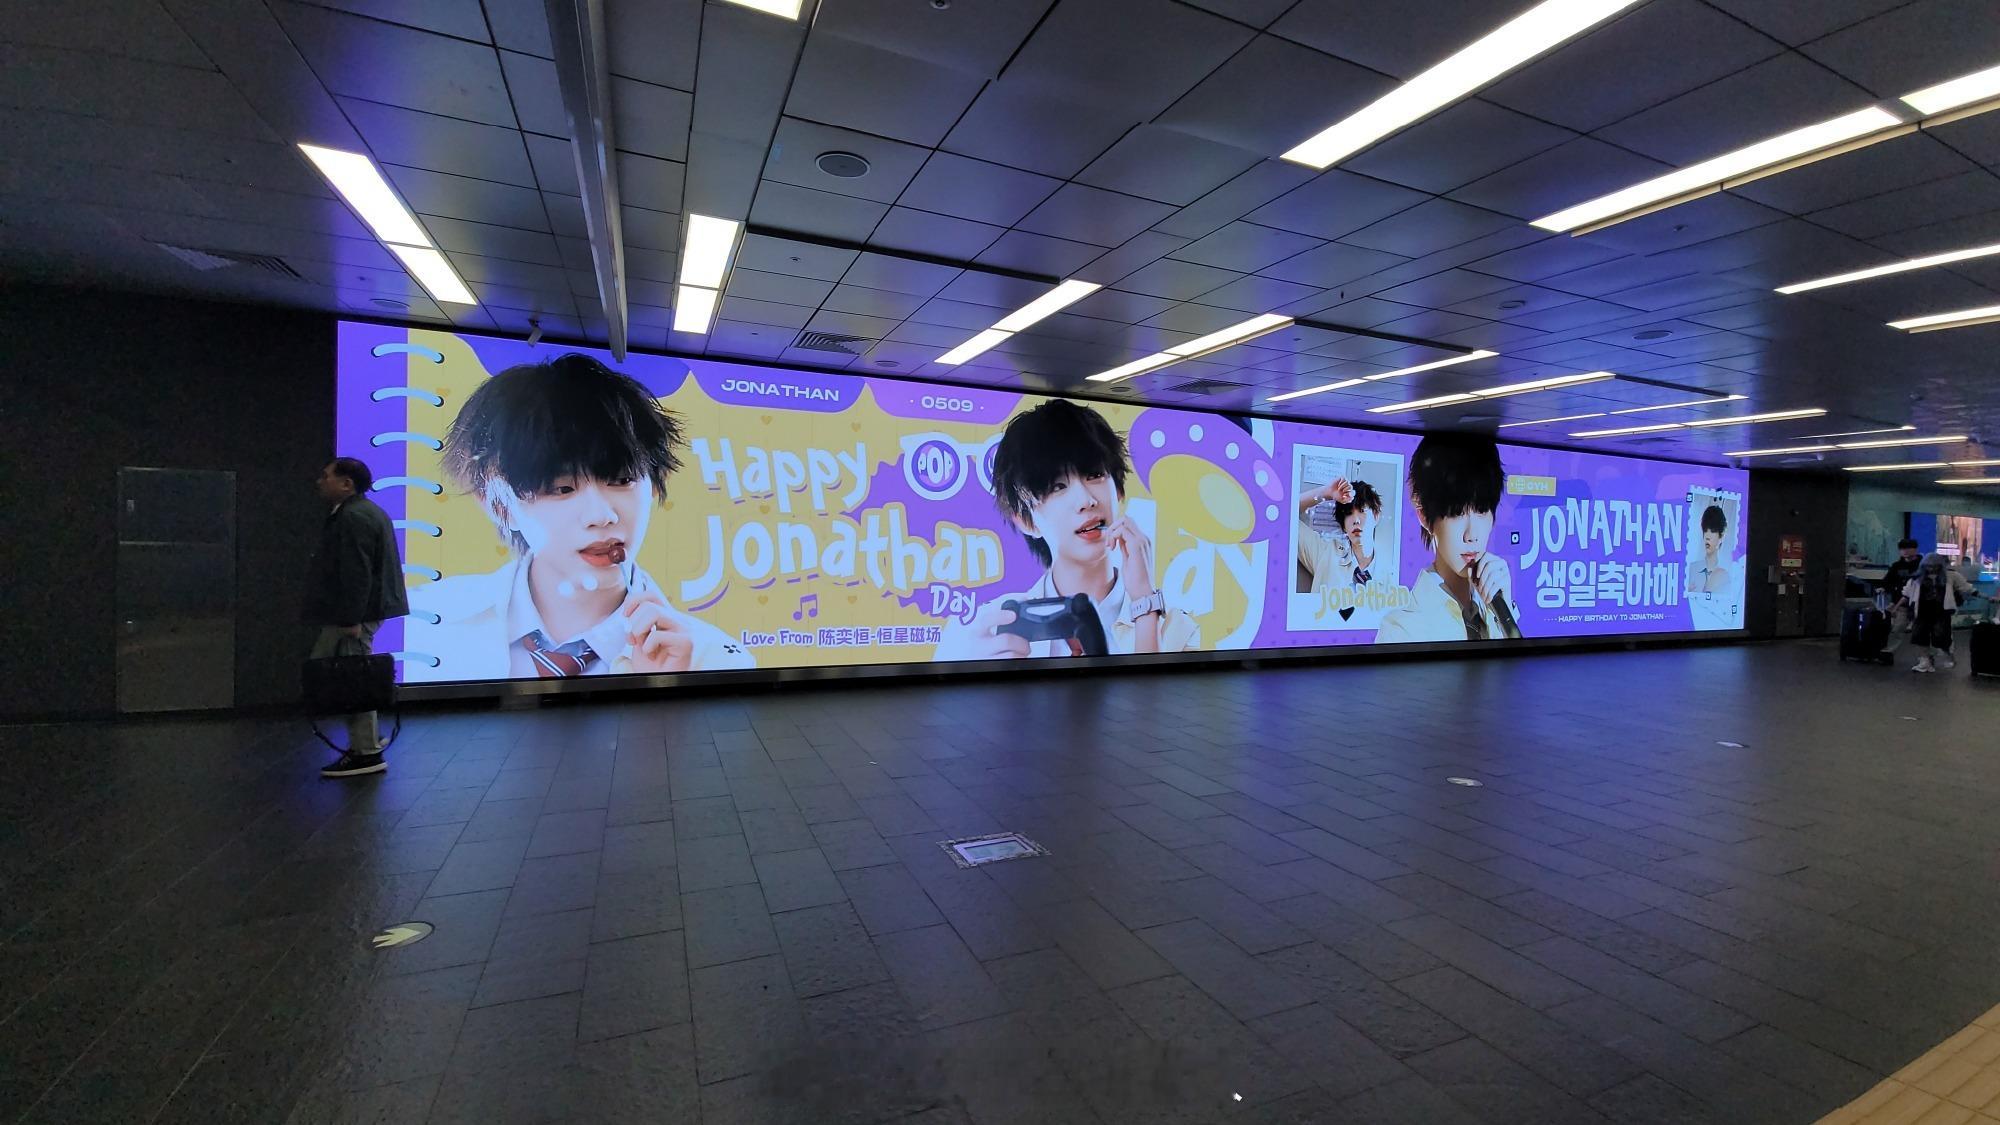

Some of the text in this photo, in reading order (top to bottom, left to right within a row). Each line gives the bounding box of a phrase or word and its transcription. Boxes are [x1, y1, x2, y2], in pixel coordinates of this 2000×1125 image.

[721, 379, 840, 401] JONATHAN
[921, 395, 974, 412] 0509
[691, 437, 867, 513] Happy
[918, 446, 953, 484] POP
[1521, 497, 1682, 570] JONATHAN
[680, 508, 1000, 602] Jonathan
[929, 586, 976, 617] Day
[1314, 579, 1410, 620] Jonathan
[1536, 560, 1679, 609] 생일축하해
[743, 626, 941, 646] Love From 陈奕恒-恒星磁场
[1558, 615, 1583, 623] HAPPY
[1584, 613, 1619, 622] BIRTHDAY
[1628, 612, 1665, 621] JONATHAN
